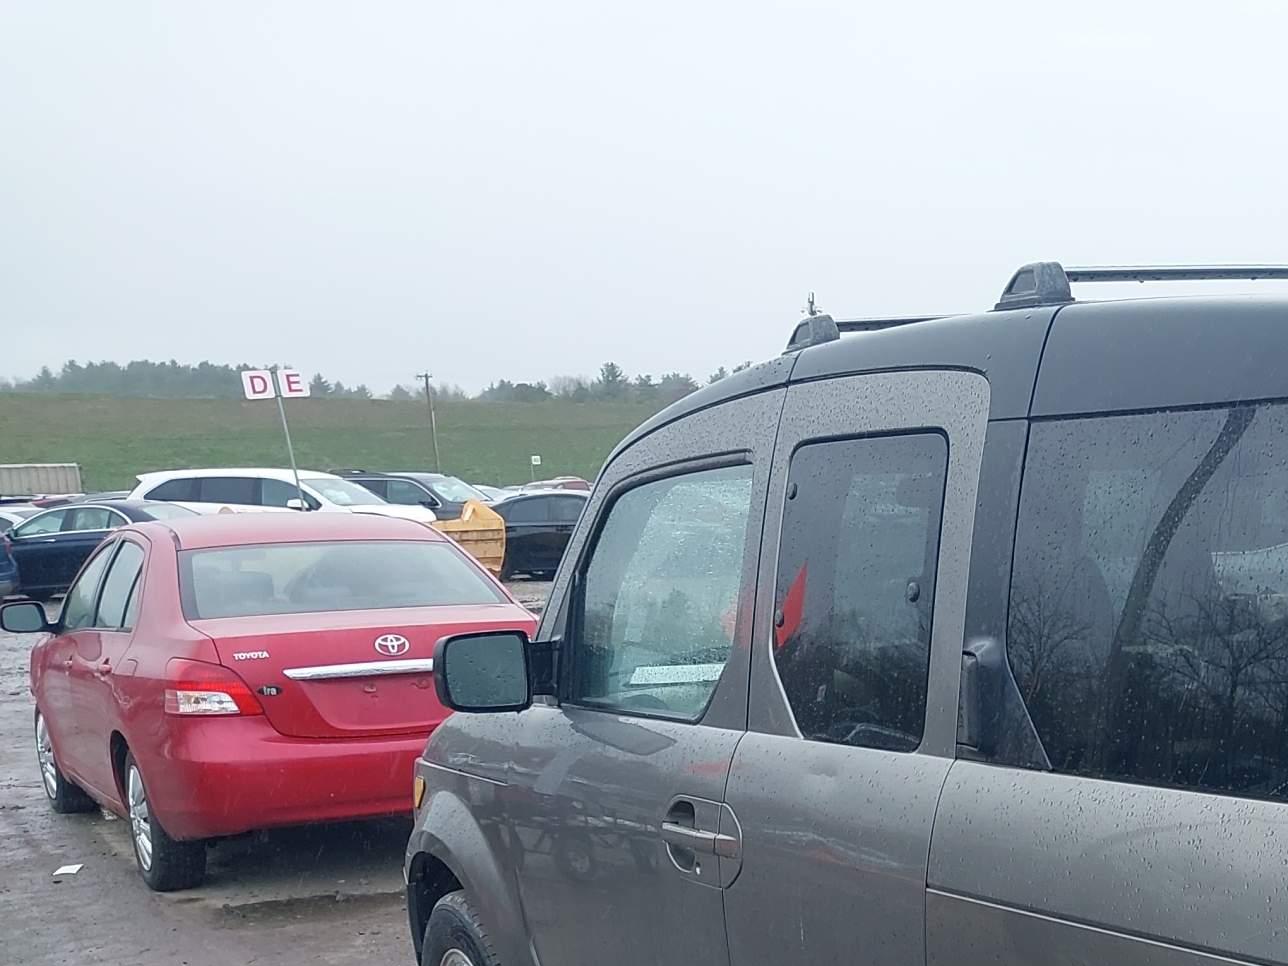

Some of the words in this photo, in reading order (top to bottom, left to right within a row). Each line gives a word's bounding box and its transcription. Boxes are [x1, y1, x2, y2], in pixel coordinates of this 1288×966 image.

[248, 375, 268, 394] D
[285, 373, 304, 393] E
[233, 651, 270, 660] TOYOTA
